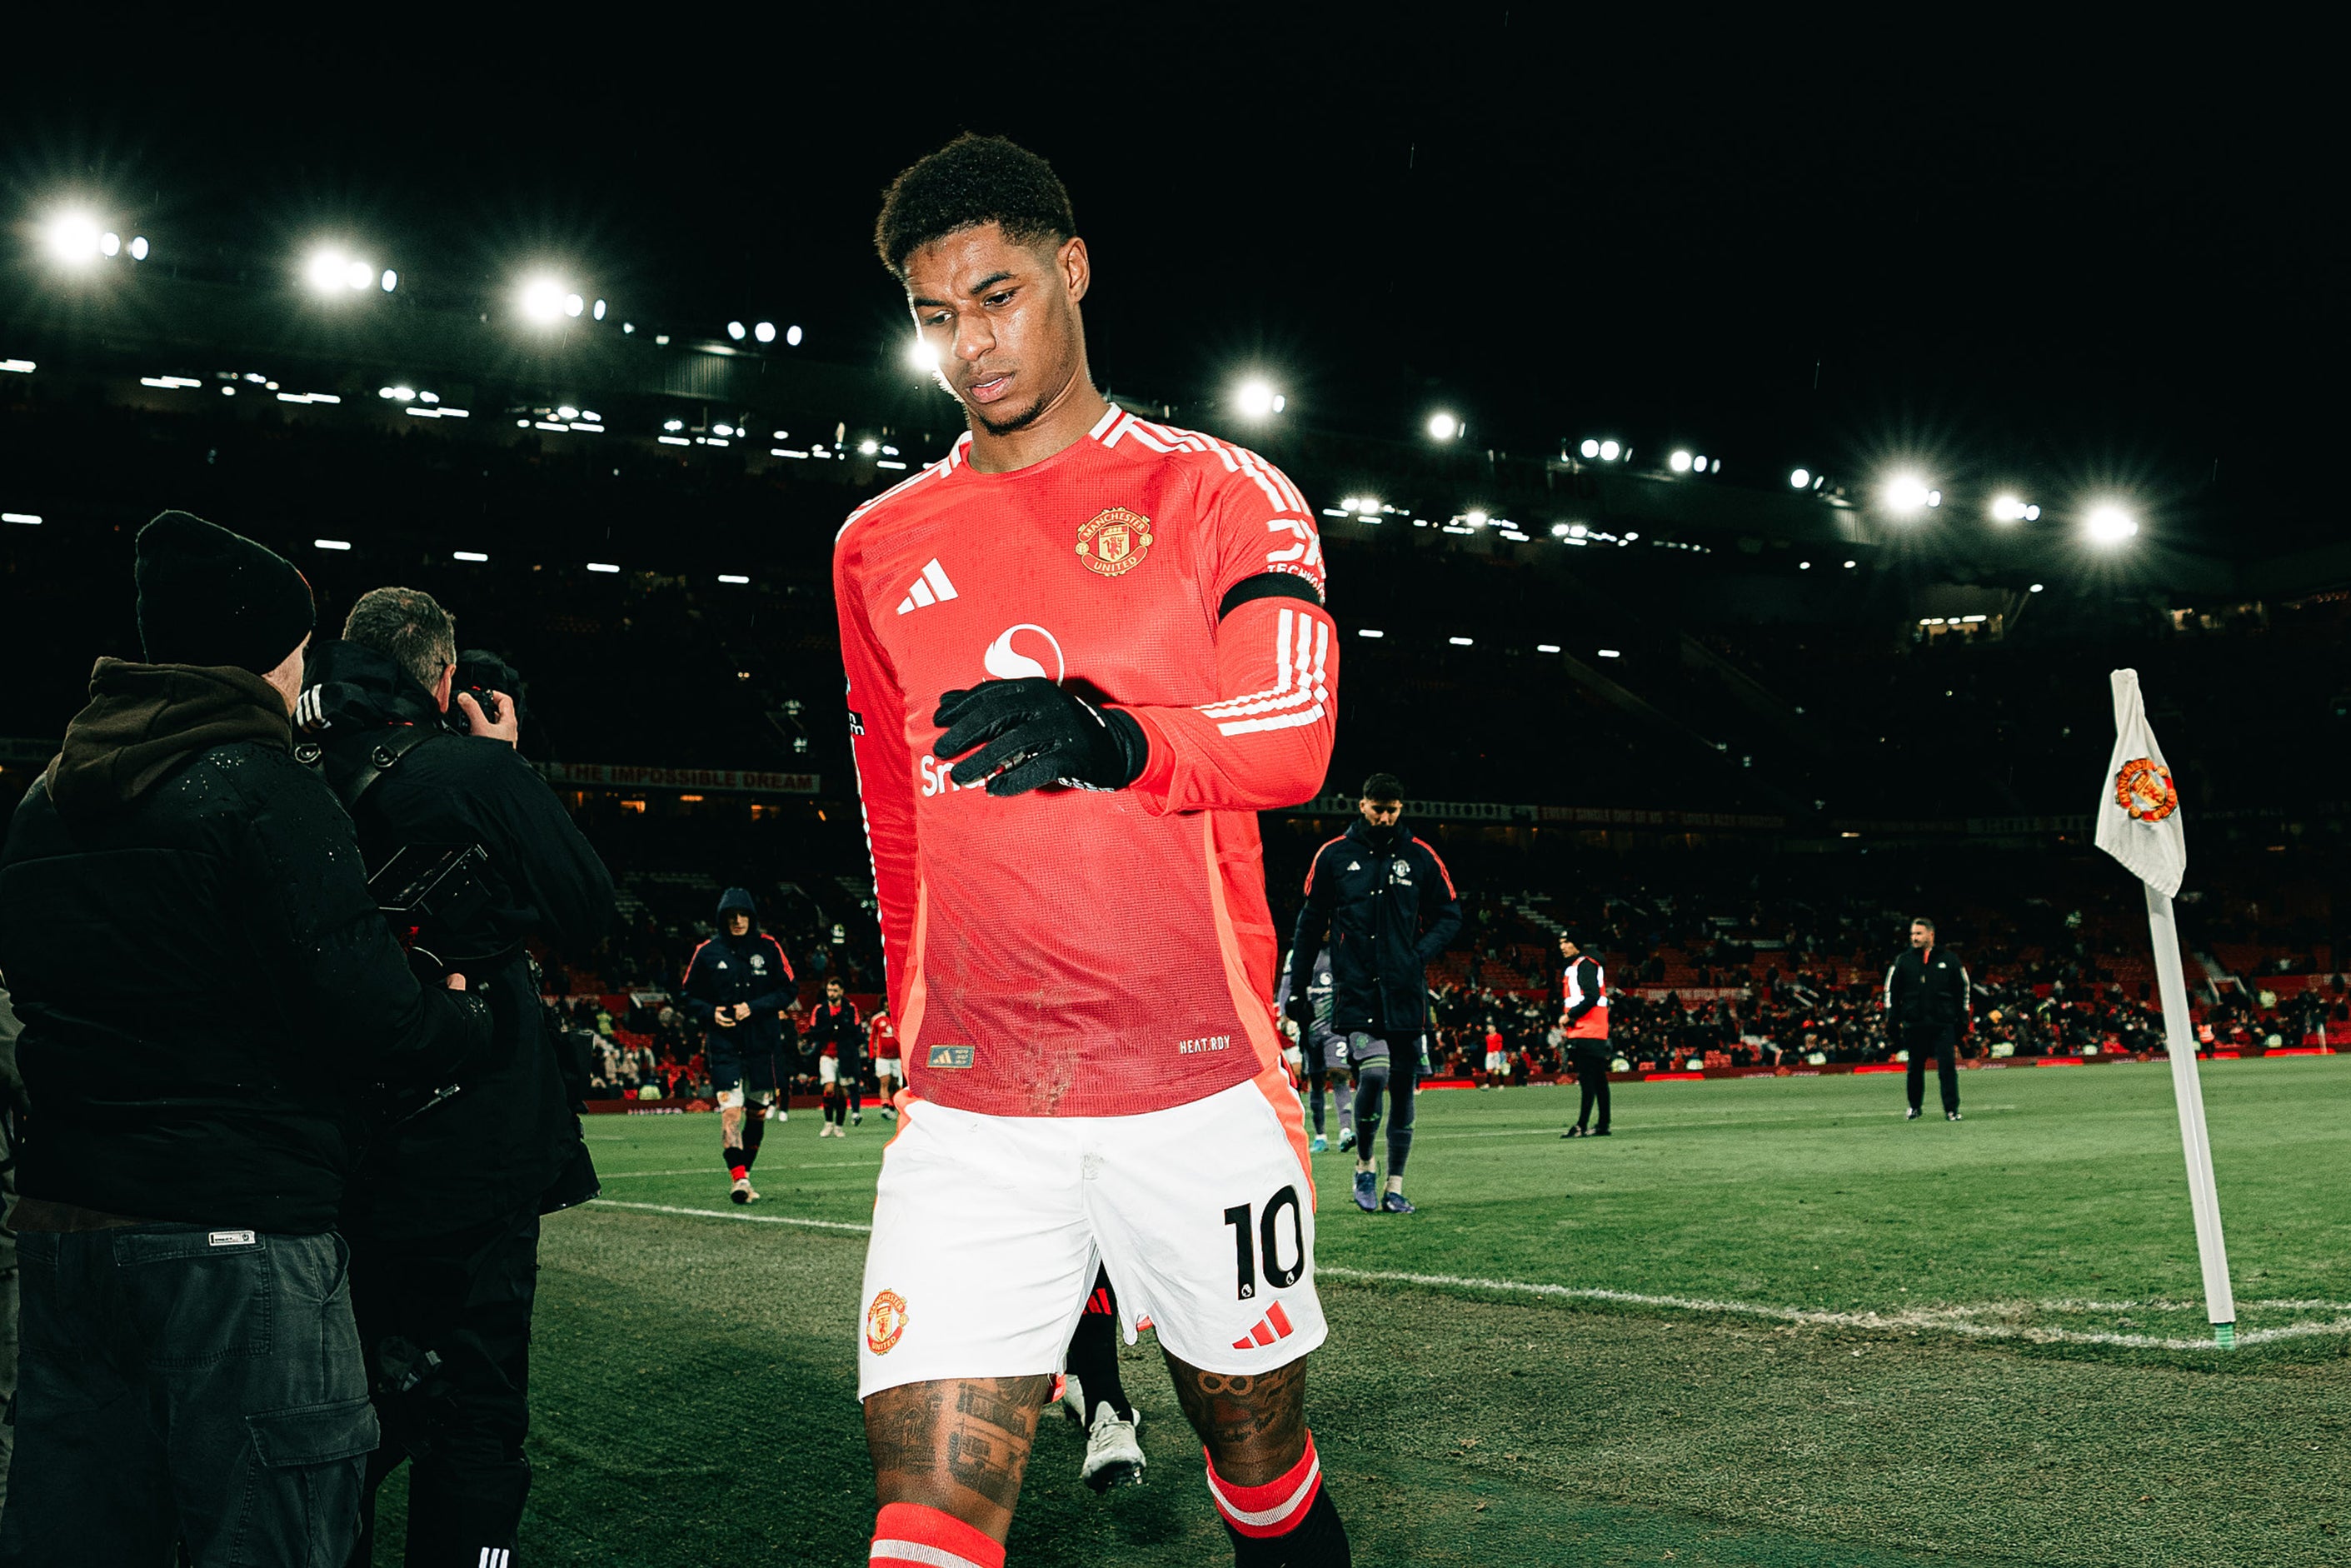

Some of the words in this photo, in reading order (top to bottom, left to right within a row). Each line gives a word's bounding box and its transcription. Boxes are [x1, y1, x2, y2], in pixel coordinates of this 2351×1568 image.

[1083, 512, 1146, 538] MANCHESTER
[1094, 557, 1137, 572] UNITED
[562, 764, 603, 782] THE
[611, 766, 736, 788] IMPOSSIBLE
[742, 772, 813, 791] DREAM
[1180, 1035, 1230, 1054] HEAT.RDY
[1224, 1184, 1305, 1301] 10
[869, 1293, 904, 1319] MANCHESTER
[872, 1336, 896, 1351] UNITED
